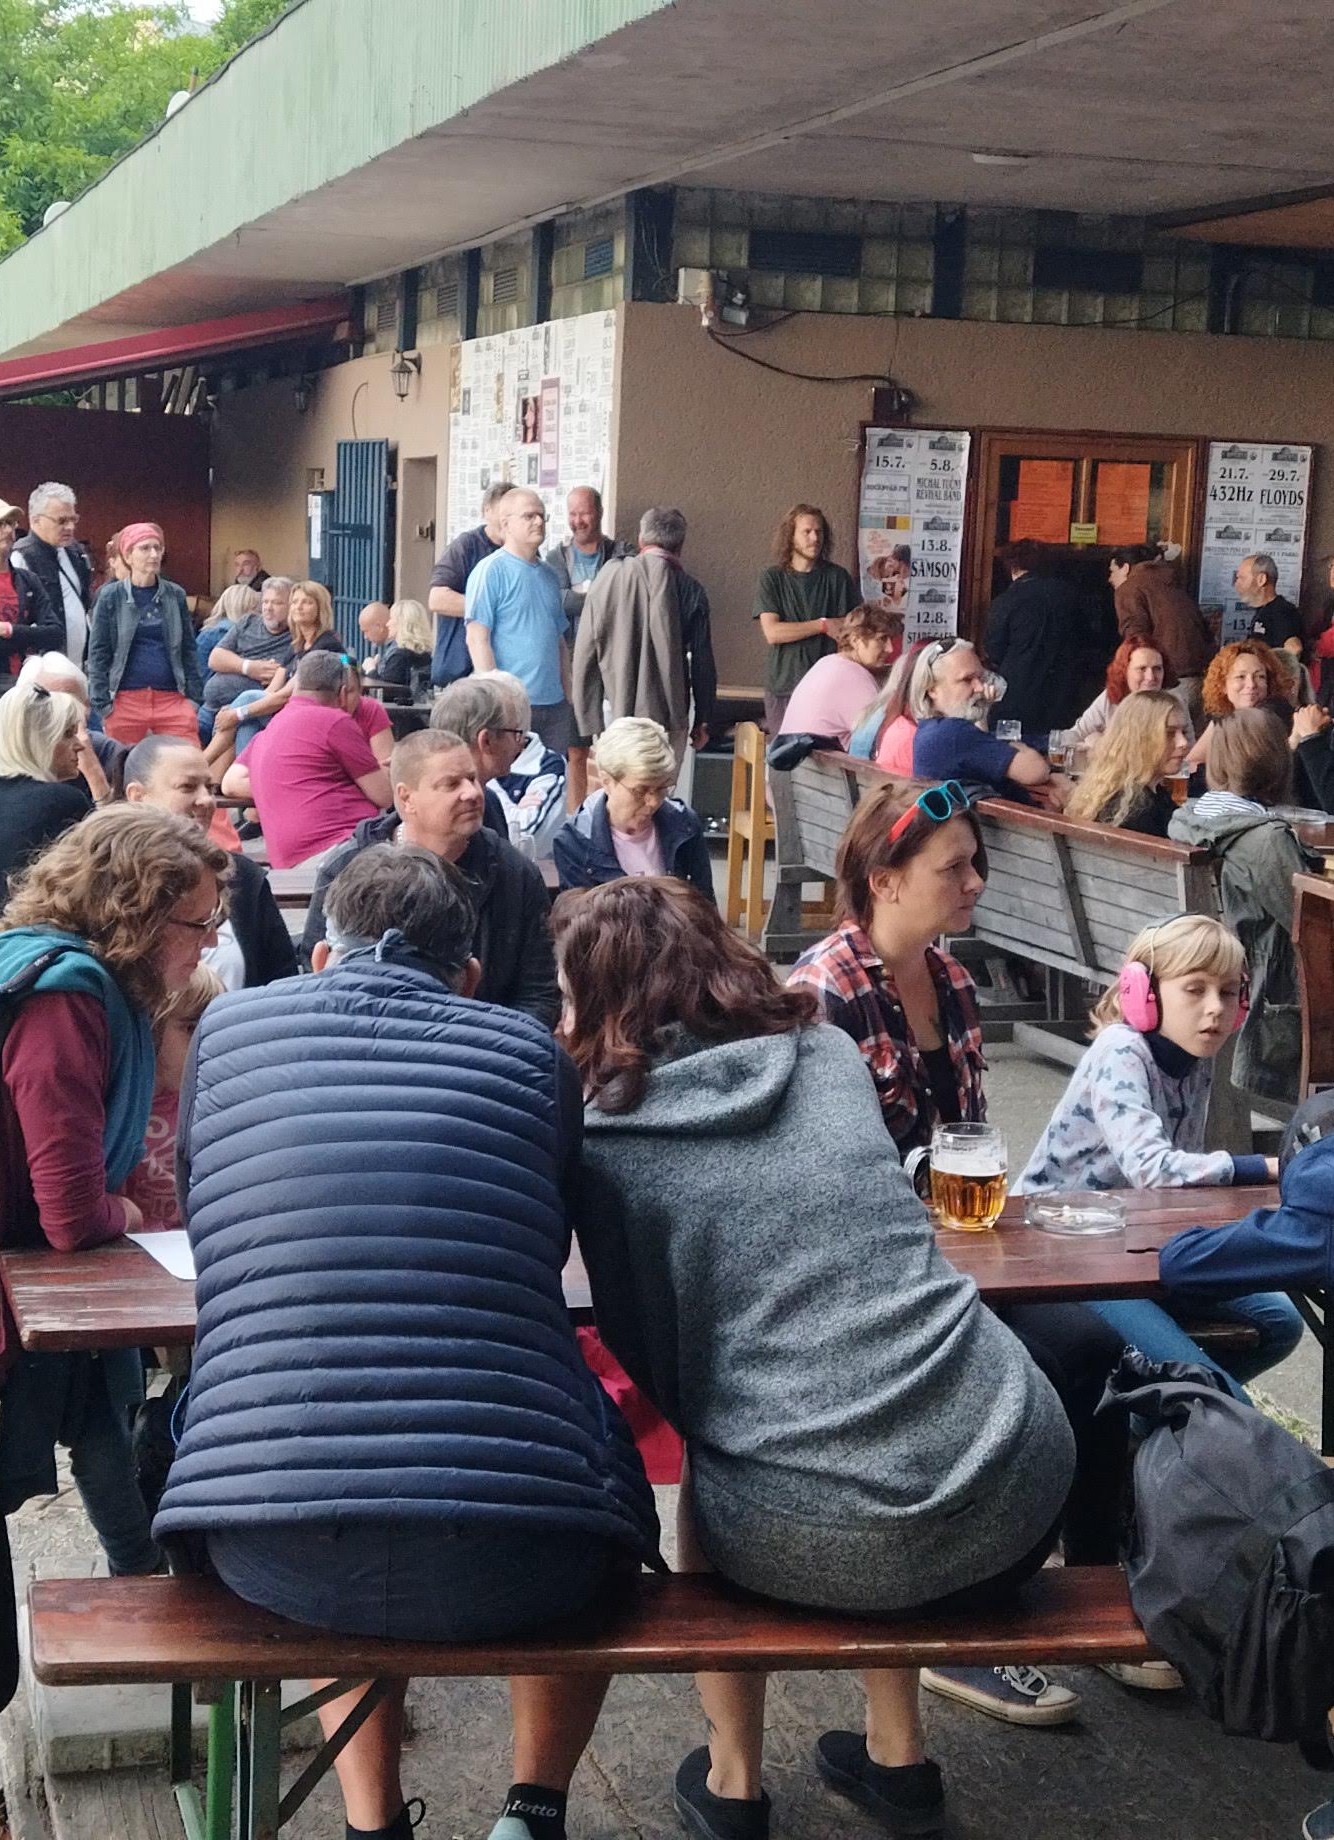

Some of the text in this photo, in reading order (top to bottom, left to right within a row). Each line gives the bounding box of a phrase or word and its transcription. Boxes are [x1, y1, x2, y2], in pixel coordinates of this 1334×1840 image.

[875, 455, 906, 468] 15.7.
[930, 459, 955, 472] 5.8.
[1219, 466, 1249, 480] 21.7.
[1268, 469, 1300, 482] 29.7.
[1209, 484, 1254, 502] 432Hz
[1259, 489, 1304, 506] FLOYDS
[921, 539, 952, 552] 13.8.
[910, 560, 957, 578] SAMSON
[917, 611, 948, 624] 12.8.
